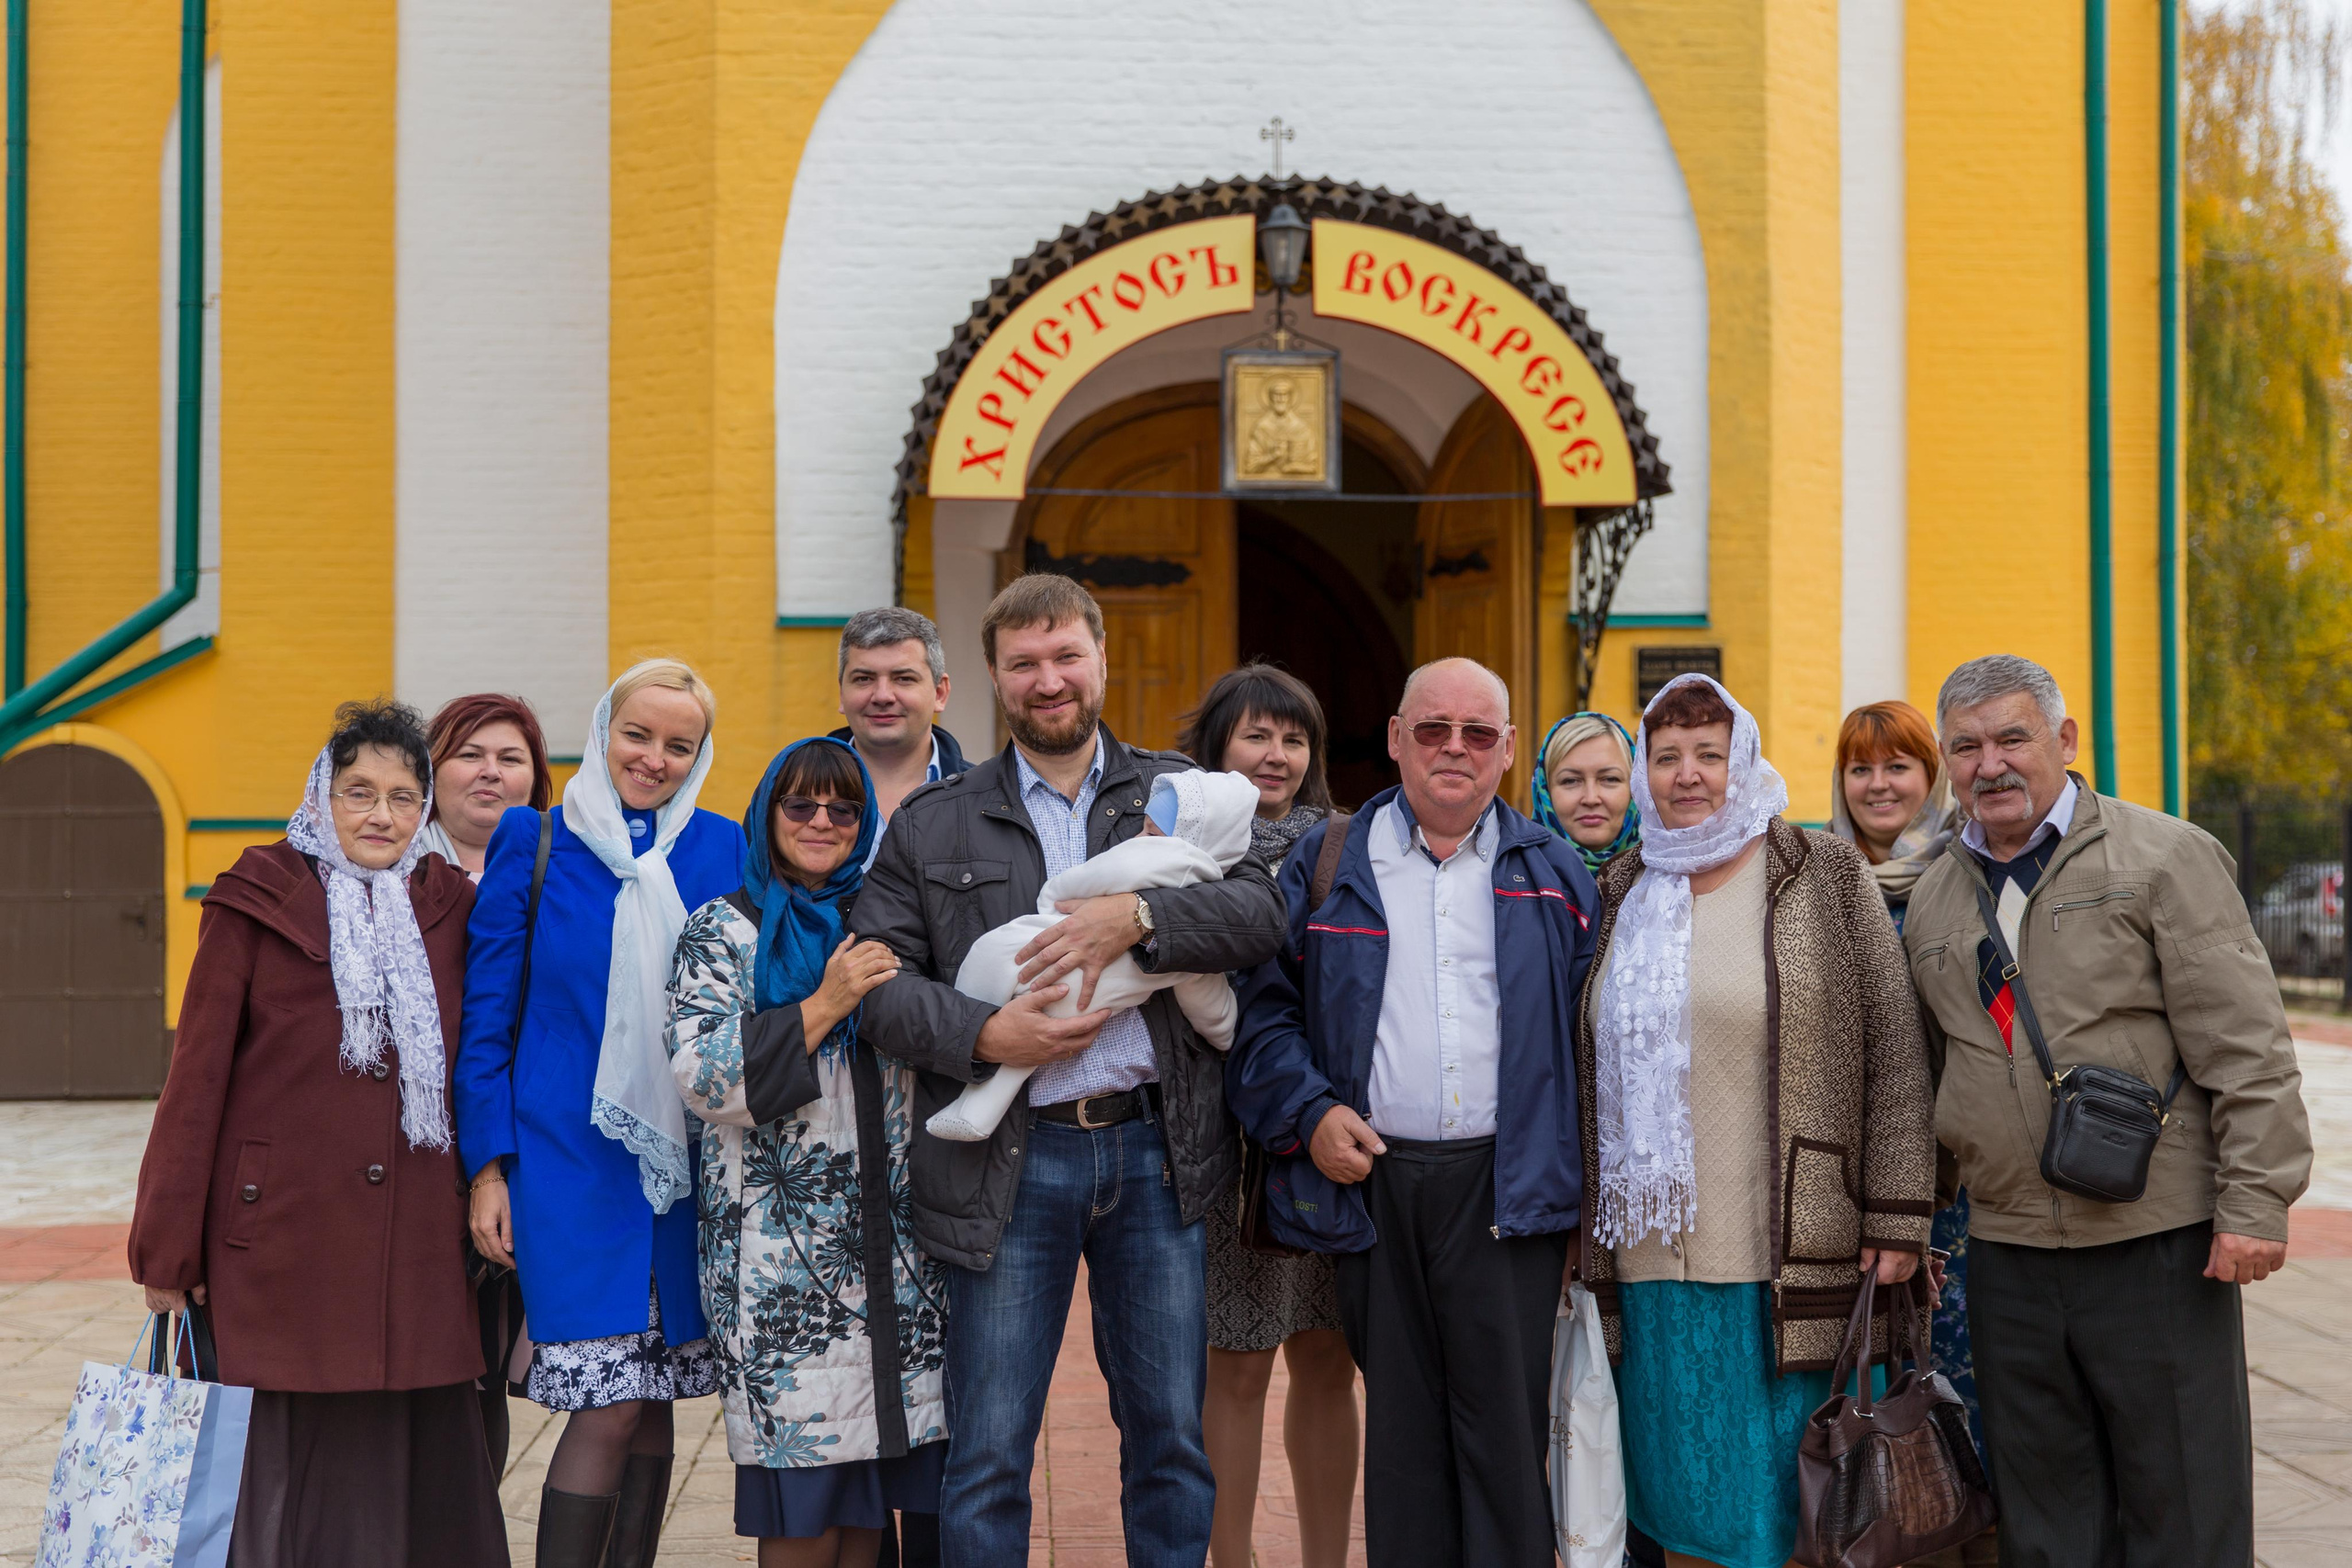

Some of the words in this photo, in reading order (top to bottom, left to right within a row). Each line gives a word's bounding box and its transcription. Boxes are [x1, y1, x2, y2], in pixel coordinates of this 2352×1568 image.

[958, 243, 1239, 482] ХРИСТОСЪ
[1339, 250, 1605, 479] ВОСКРЕСЕ
[1327, 821, 1346, 860] YING
